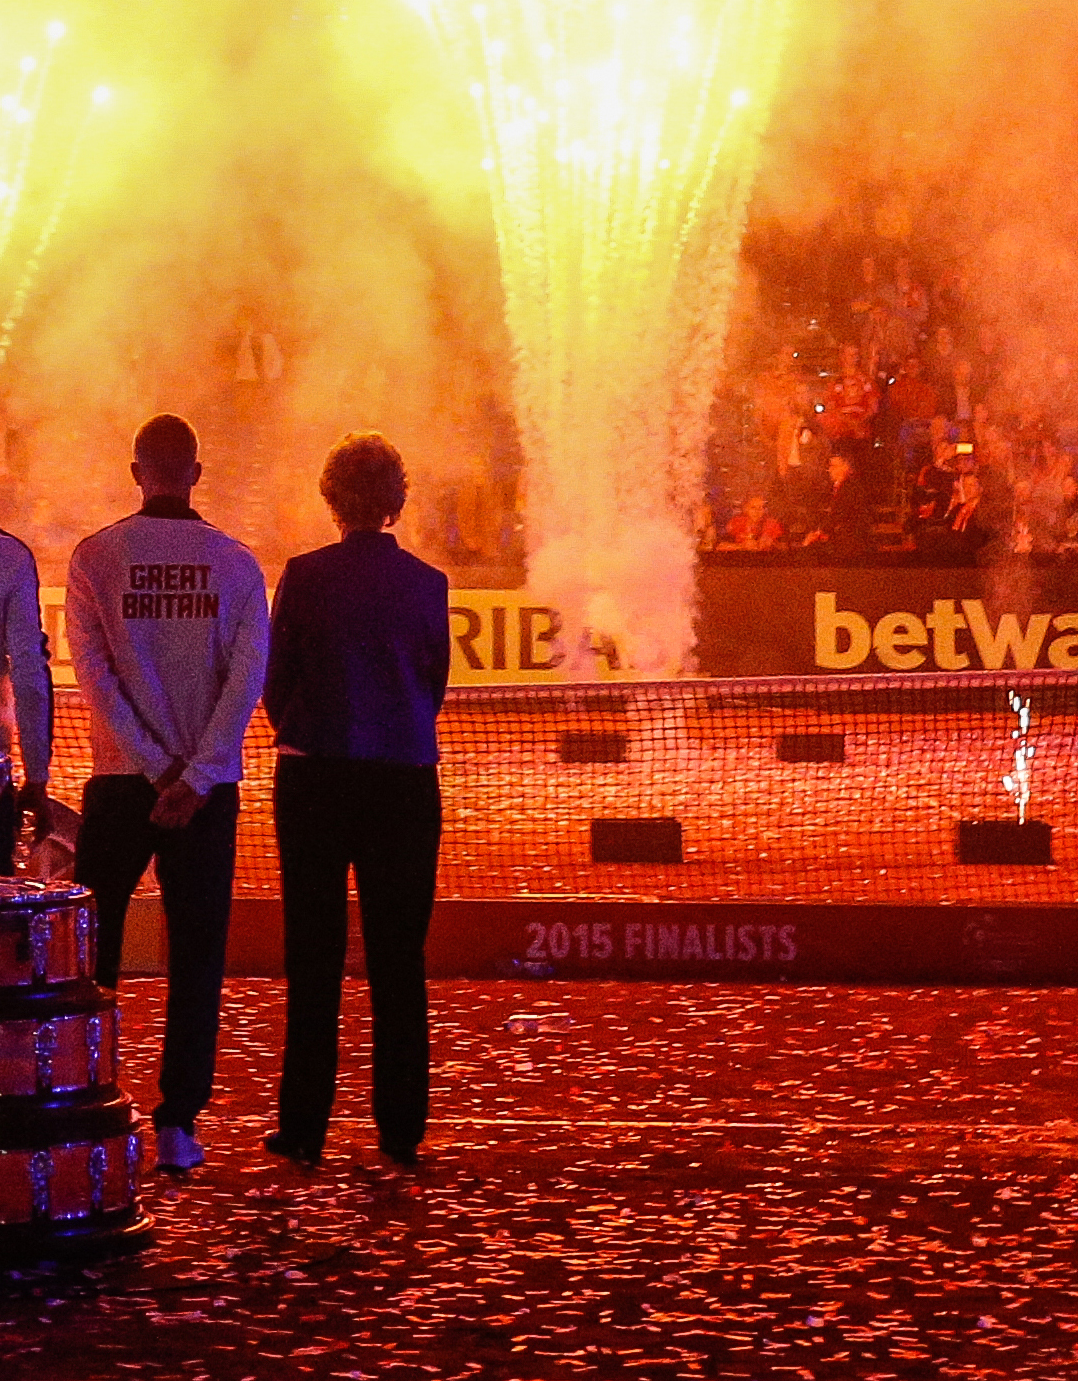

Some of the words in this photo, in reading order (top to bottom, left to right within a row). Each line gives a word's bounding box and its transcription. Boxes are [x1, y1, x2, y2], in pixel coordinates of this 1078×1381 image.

[130, 565, 212, 590] GREAT
[122, 593, 219, 619] BRITAIN
[525, 922, 614, 959] 2015
[624, 923, 798, 961] FINALISTS
